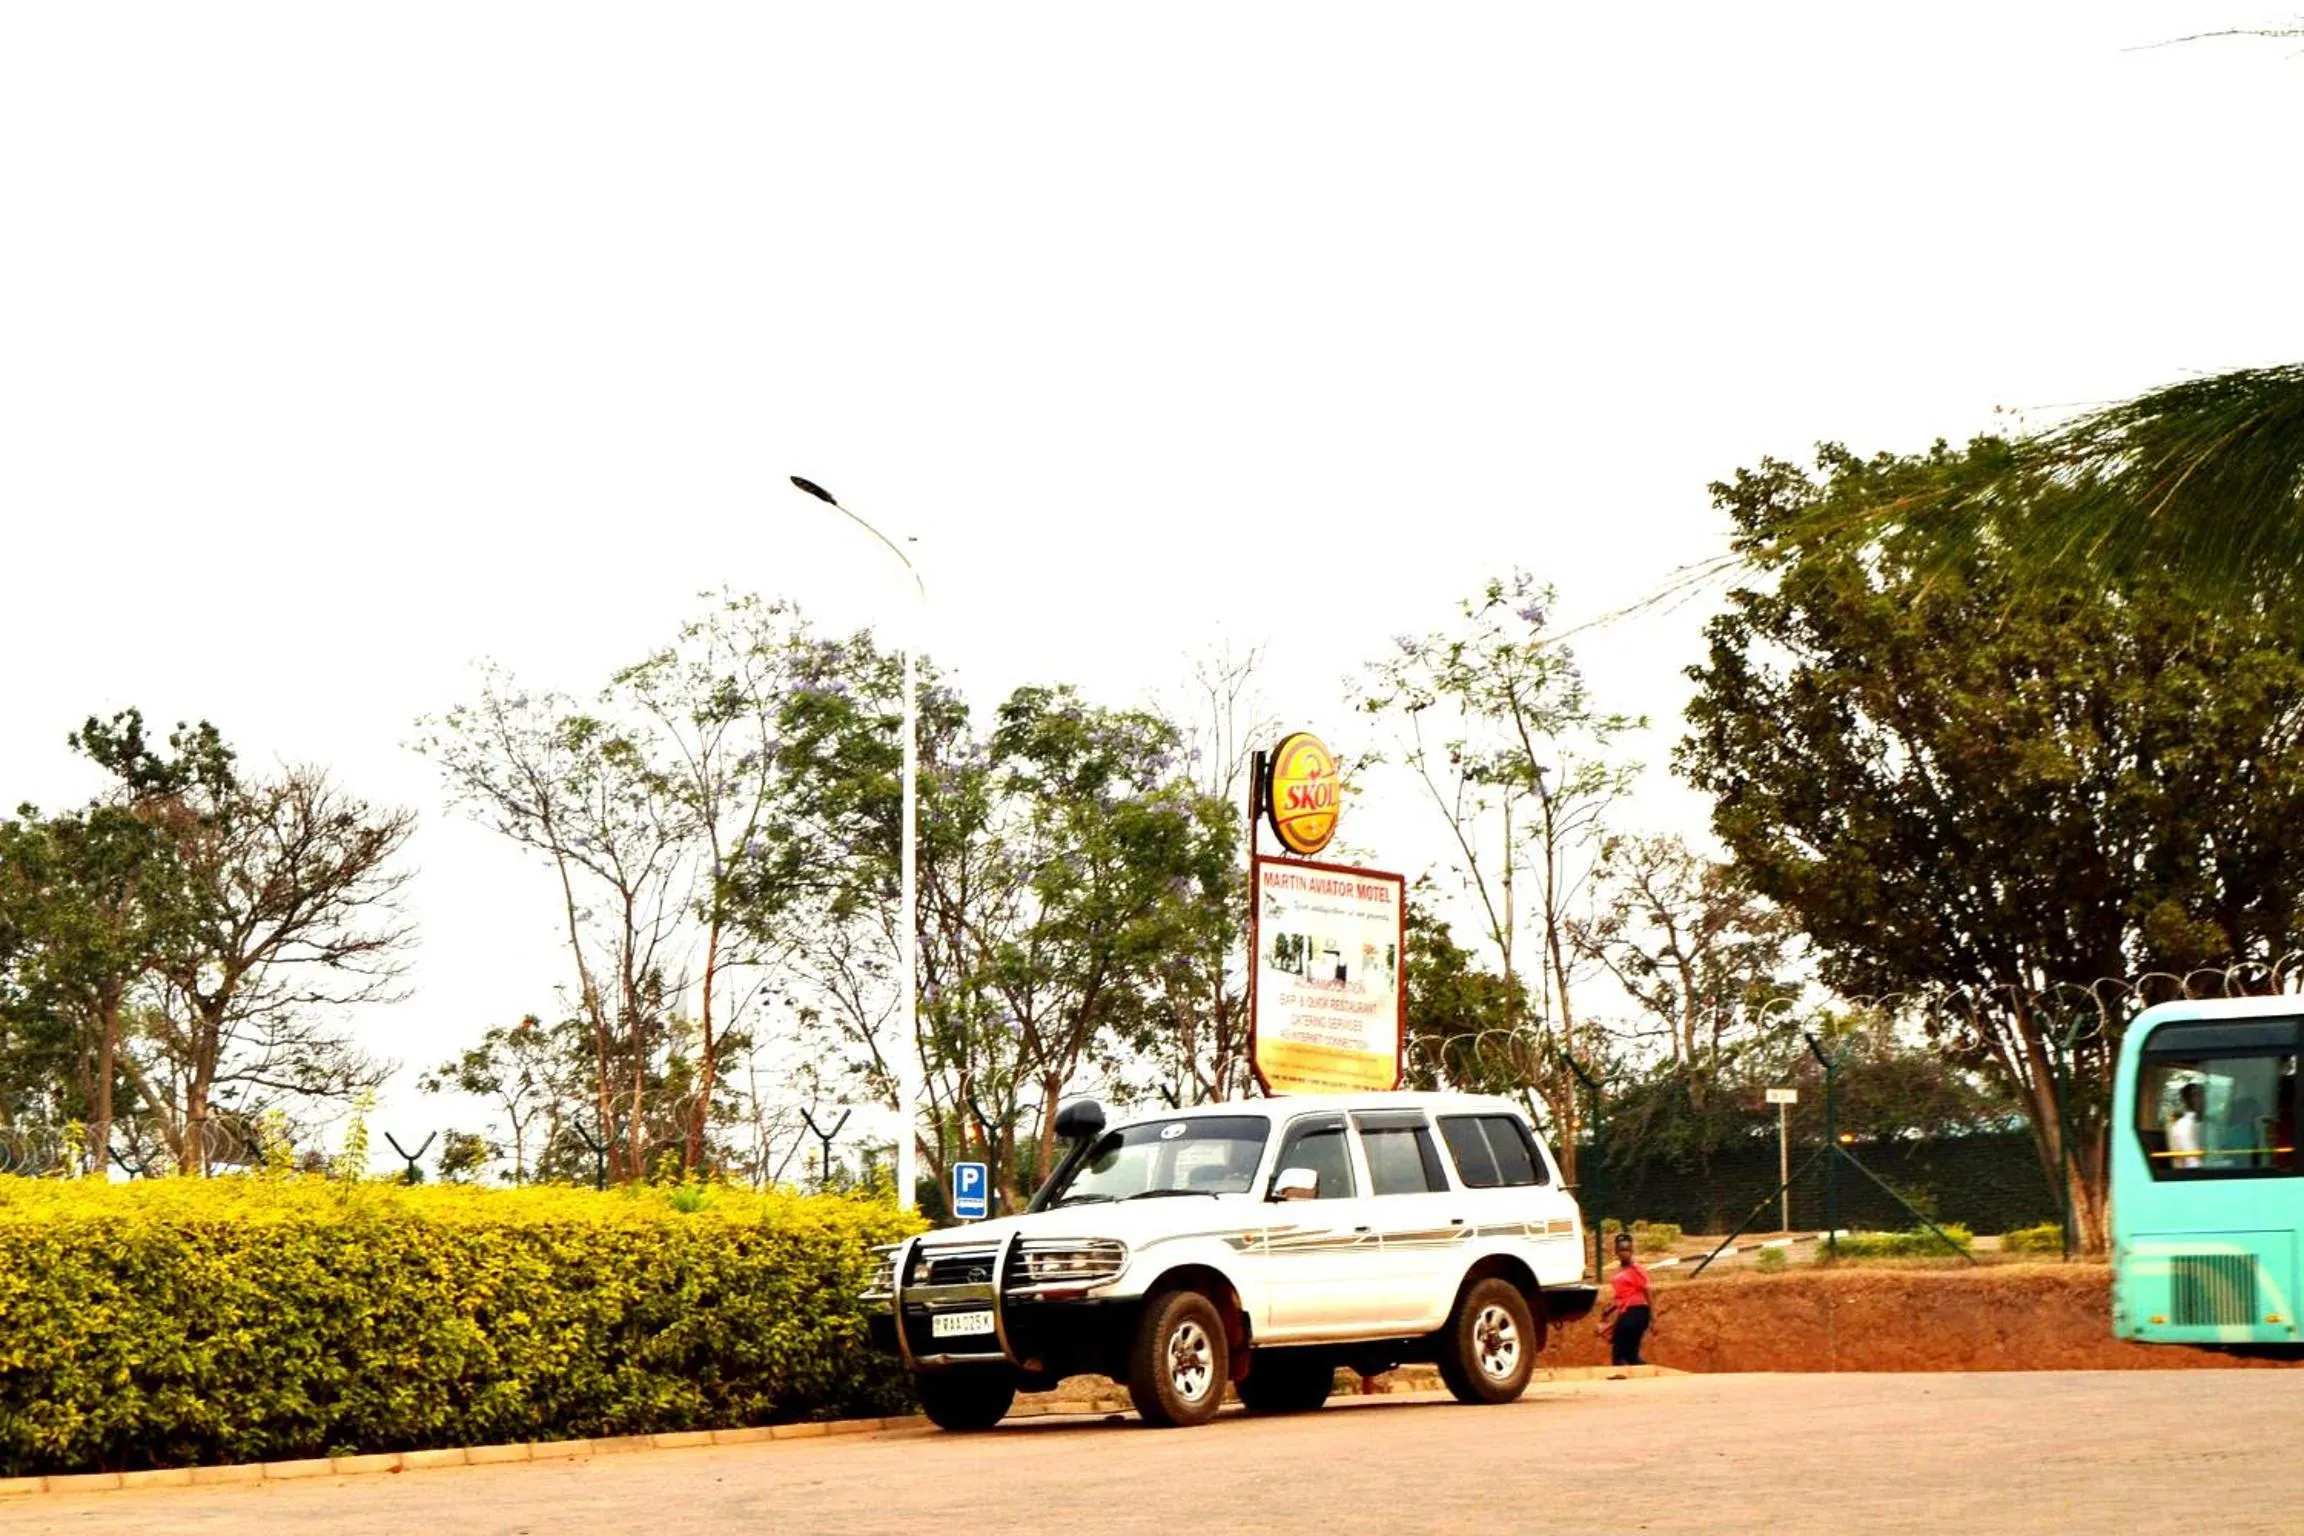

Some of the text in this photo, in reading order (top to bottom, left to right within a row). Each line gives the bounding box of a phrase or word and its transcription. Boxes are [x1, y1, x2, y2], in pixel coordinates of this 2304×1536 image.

[1285, 783, 1336, 810] SKOL
[1264, 872, 1391, 903] MARTIN AVIATOR MOTEL
[962, 1168, 979, 1192] P
